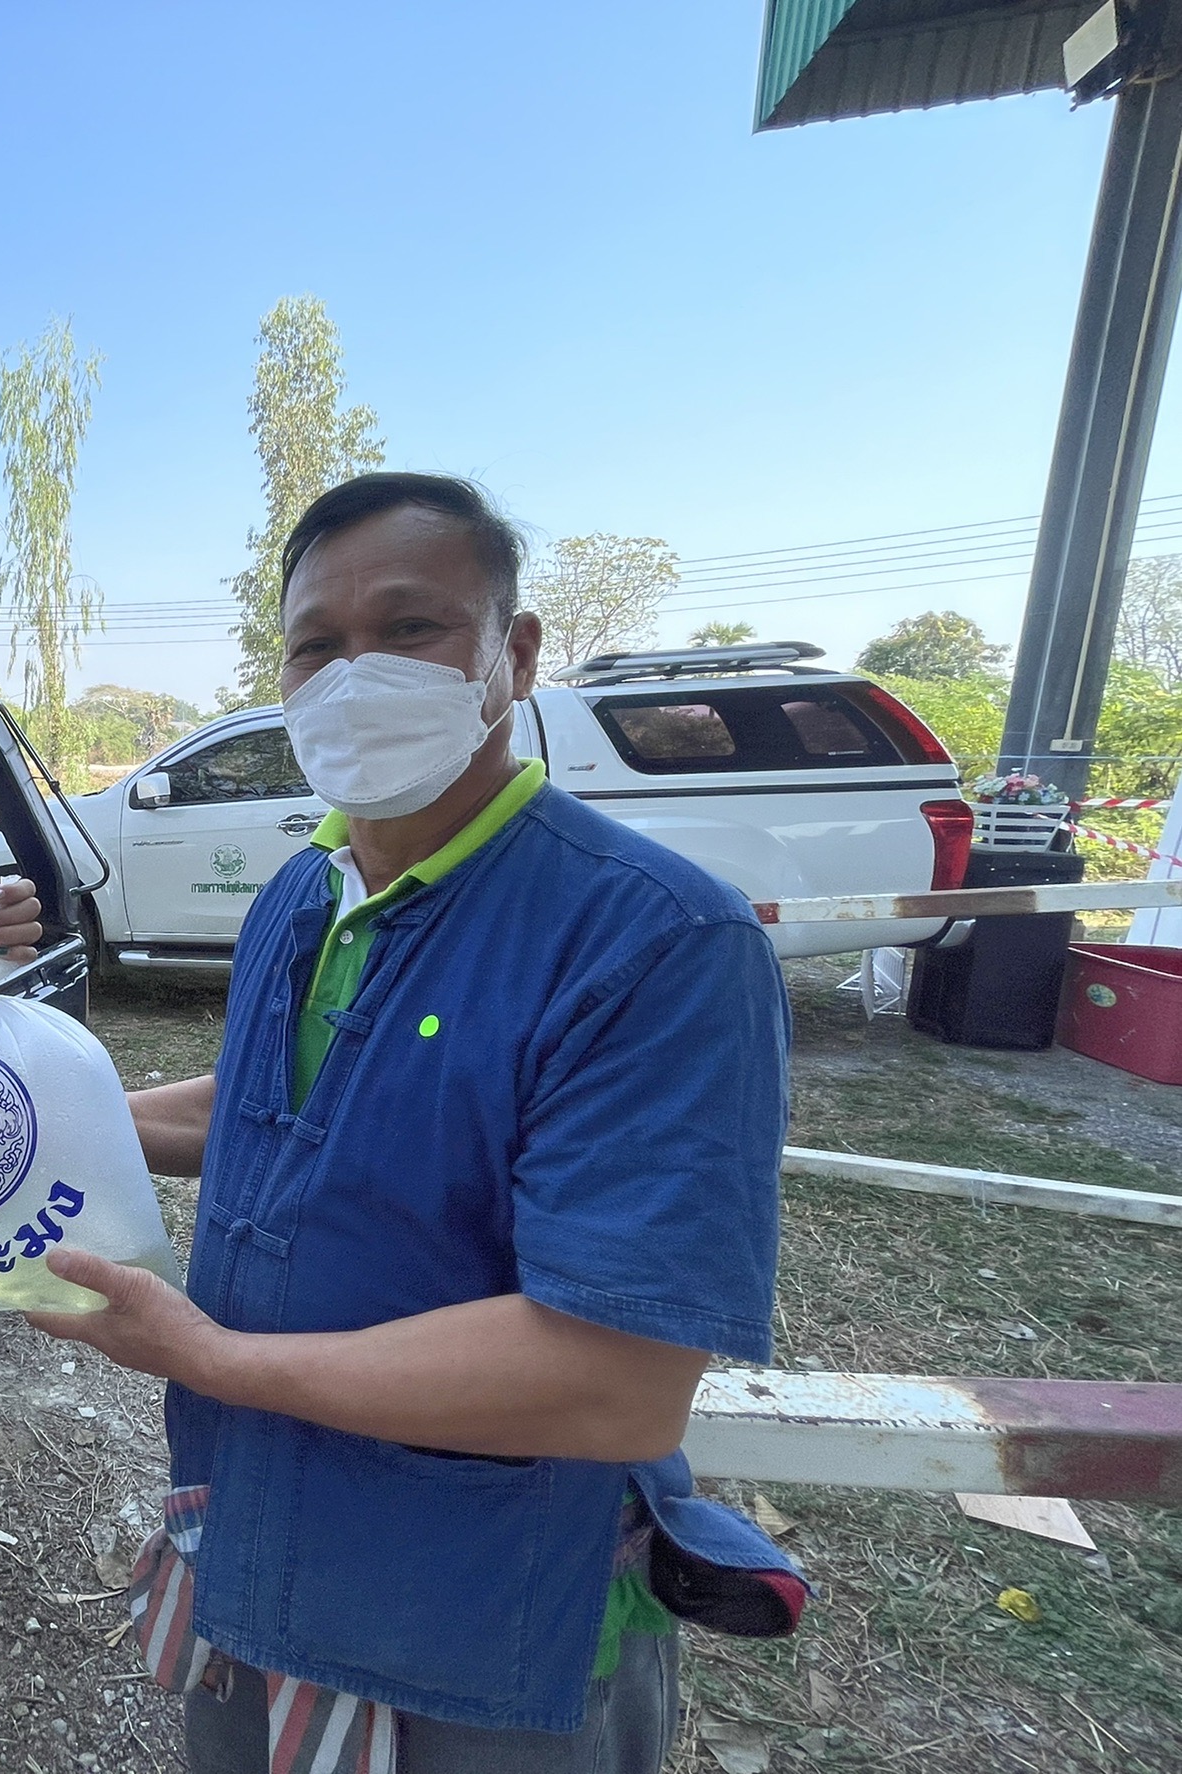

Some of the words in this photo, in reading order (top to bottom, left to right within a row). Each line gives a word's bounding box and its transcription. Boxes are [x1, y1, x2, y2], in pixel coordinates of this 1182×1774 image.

[190, 880, 267, 896] กรมตรวจบัญชีสหกร
